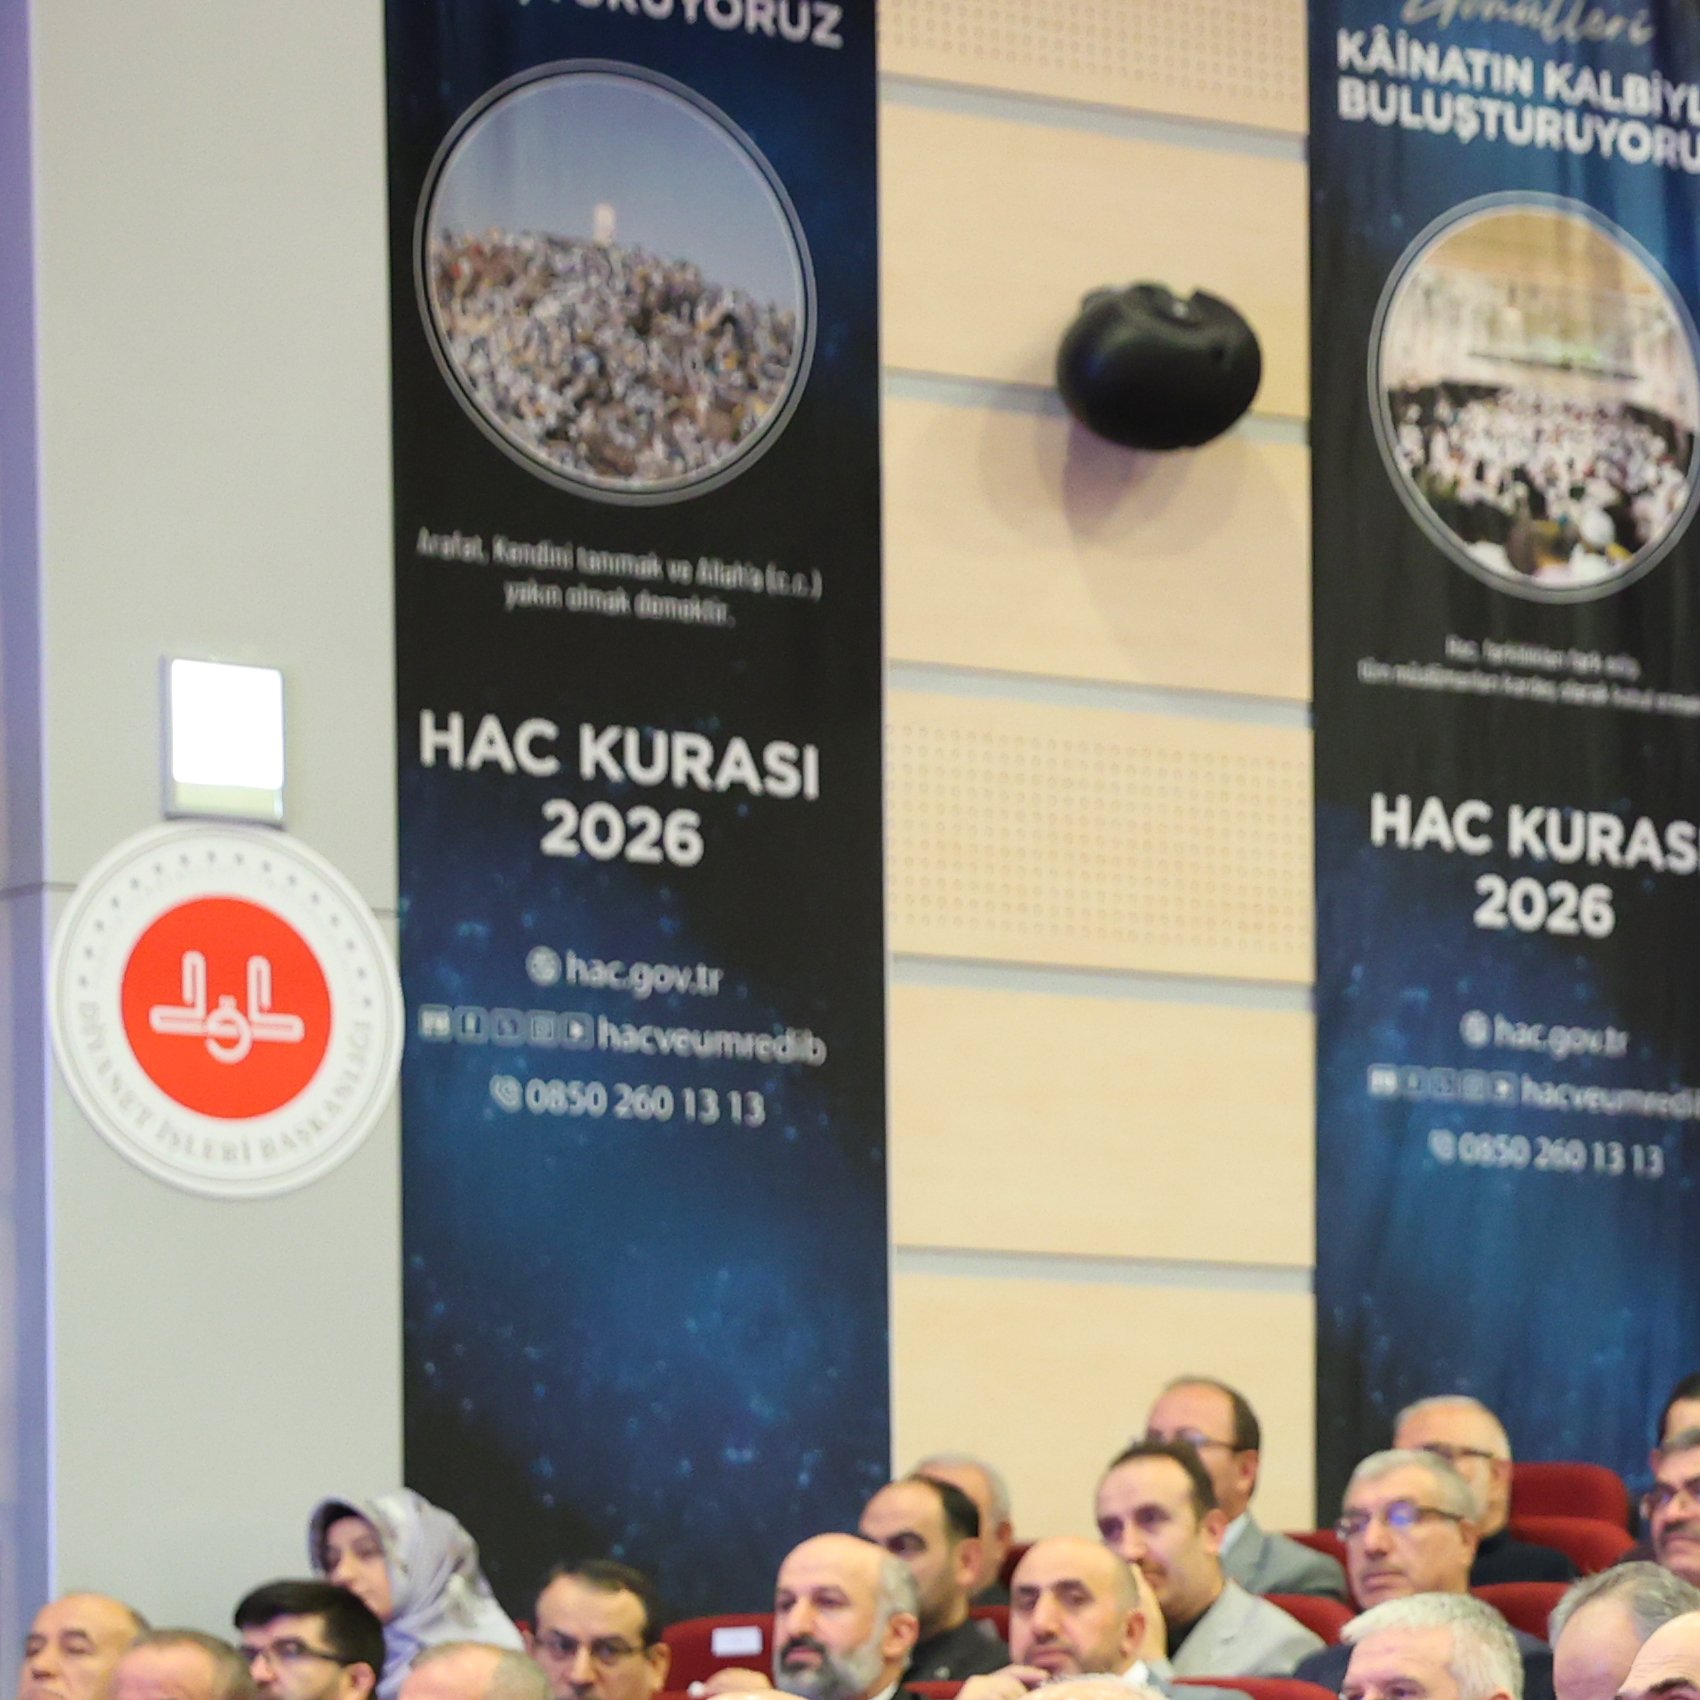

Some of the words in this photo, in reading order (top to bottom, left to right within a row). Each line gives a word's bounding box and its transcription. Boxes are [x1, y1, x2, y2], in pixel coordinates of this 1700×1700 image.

[1337, 23, 1533, 97] KÂİNATIN
[420, 708, 560, 778] HAC
[579, 722, 819, 801] KURASI
[540, 799, 705, 868] 2026
[1371, 792, 1494, 856] HAC
[1473, 873, 1616, 938] 2026
[566, 949, 724, 1000] hac.gov.tr
[1493, 1012, 1629, 1061] hac.gov.tr
[525, 1078, 607, 1116] 0850
[613, 1082, 674, 1122] 260
[684, 1086, 720, 1125] 13
[729, 1090, 766, 1128] 13
[1458, 1131, 1532, 1170] 0850
[1533, 1134, 1587, 1173] 260
[1593, 1140, 1626, 1176] 13
[1633, 1143, 1665, 1179] 13
